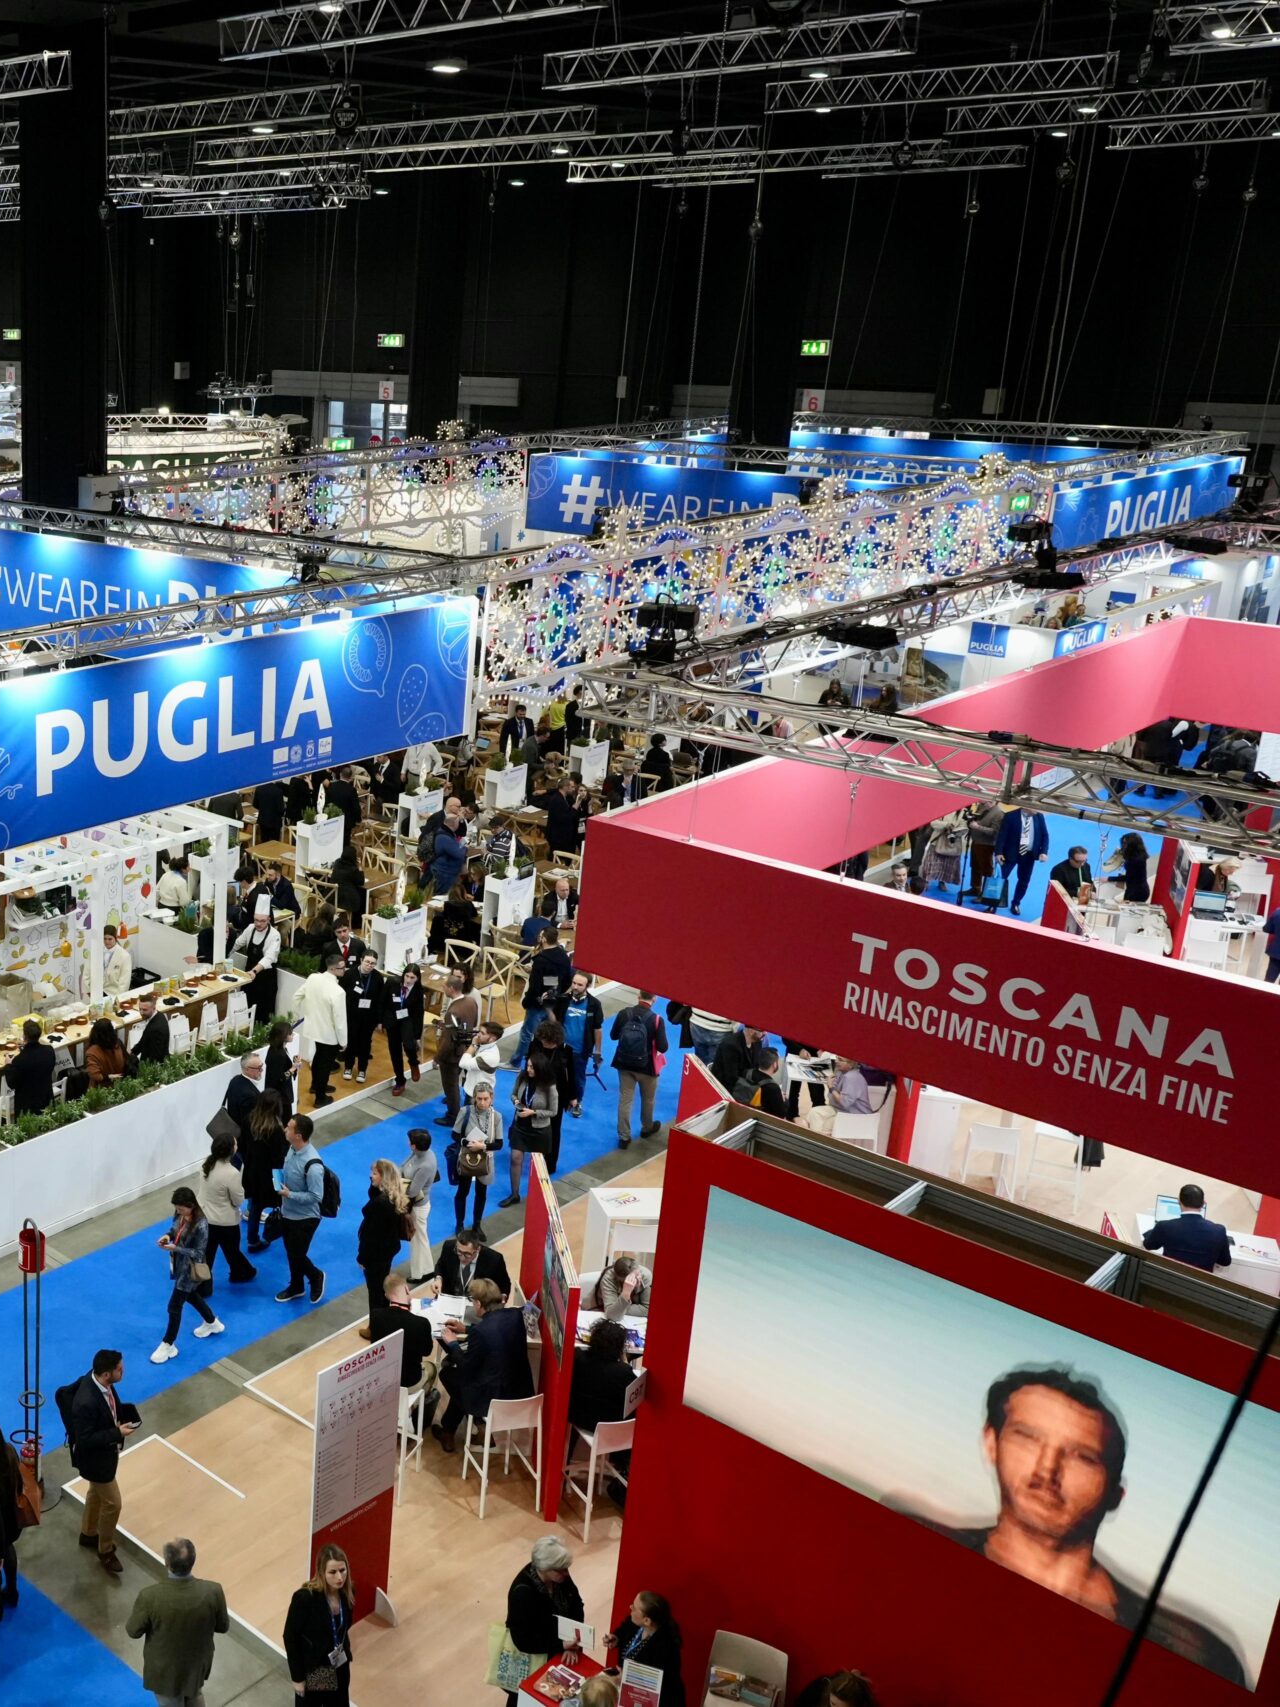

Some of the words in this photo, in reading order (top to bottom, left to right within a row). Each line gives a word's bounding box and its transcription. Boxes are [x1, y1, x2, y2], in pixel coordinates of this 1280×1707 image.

[382, 387, 391, 400] 5
[808, 396, 818, 412] 6
[1104, 484, 1192, 539] PUGLIA
[970, 641, 1004, 653] PUGLIA
[36, 658, 333, 797] PUGLIA
[851, 932, 1235, 1079] TOSCANA
[683, 1057, 691, 1076] 3
[843, 981, 1046, 1067] RINASCIMENTO
[1052, 1044, 1147, 1101] SENZA
[1157, 1074, 1234, 1125] FINE
[337, 1344, 386, 1376] TOSCANA
